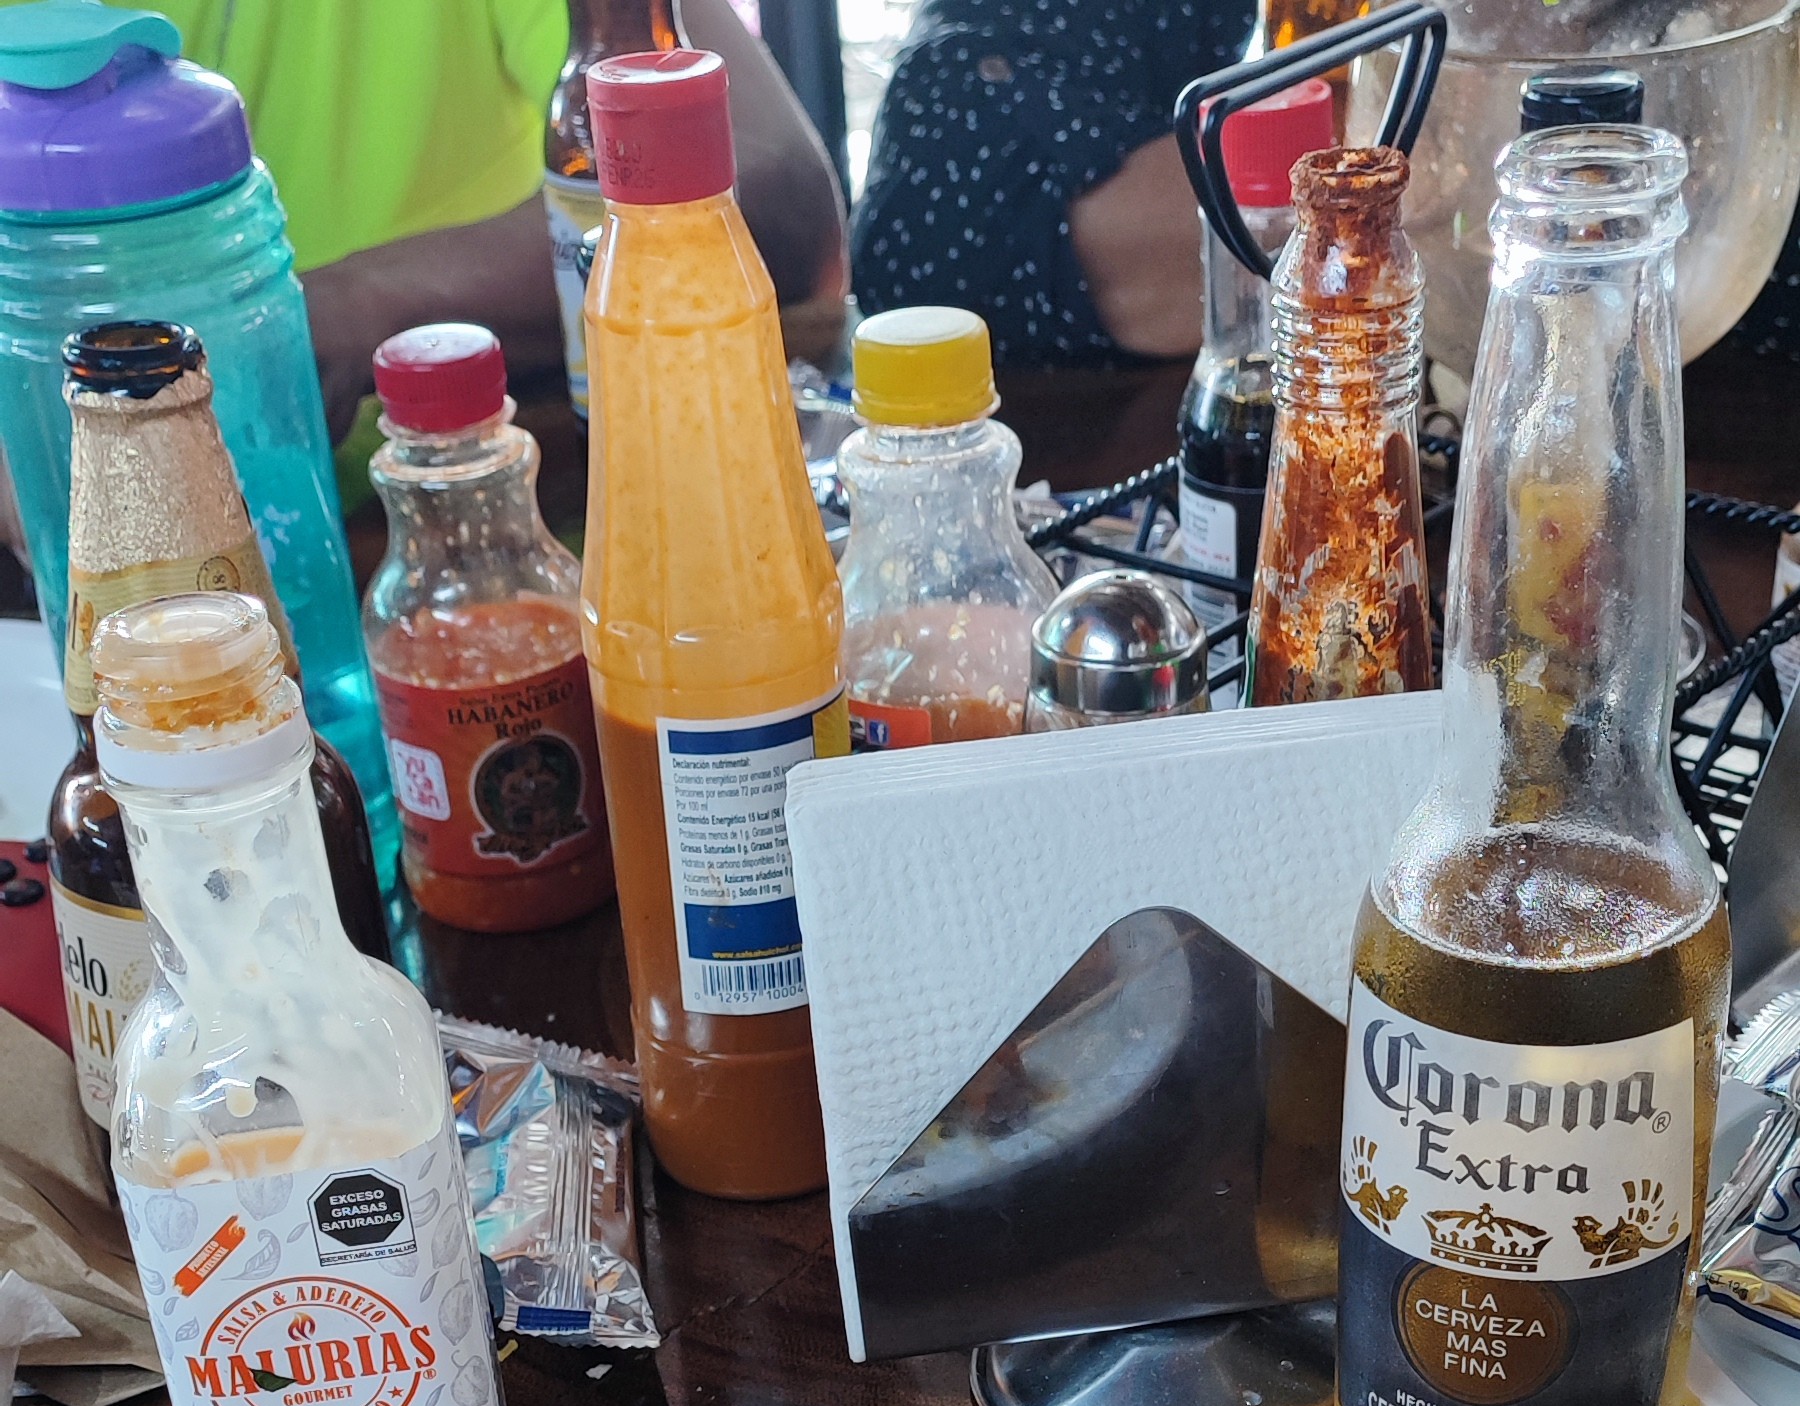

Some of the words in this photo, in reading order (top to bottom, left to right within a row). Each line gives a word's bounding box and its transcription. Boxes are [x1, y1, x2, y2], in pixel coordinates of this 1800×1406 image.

[448, 681, 574, 725] HABANERO
[495, 717, 542, 740] Rojo
[719, 992, 757, 1004] 12957
[1362, 1018, 1658, 1134] Corona
[1415, 1119, 1591, 1195] Extra
[329, 1189, 385, 1206] EXCESO
[331, 1202, 388, 1218] GRASAS
[321, 1211, 402, 1232] SATURADAS
[1461, 1288, 1499, 1313] LA
[217, 1300, 268, 1345] SALSA
[272, 1290, 288, 1306] &
[296, 1285, 387, 1324] ADEREZO
[1415, 1298, 1547, 1338] CERVEZA
[1446, 1330, 1508, 1358] MAS
[1443, 1353, 1507, 1380] FINA
[283, 1385, 353, 1406] GOURMET
